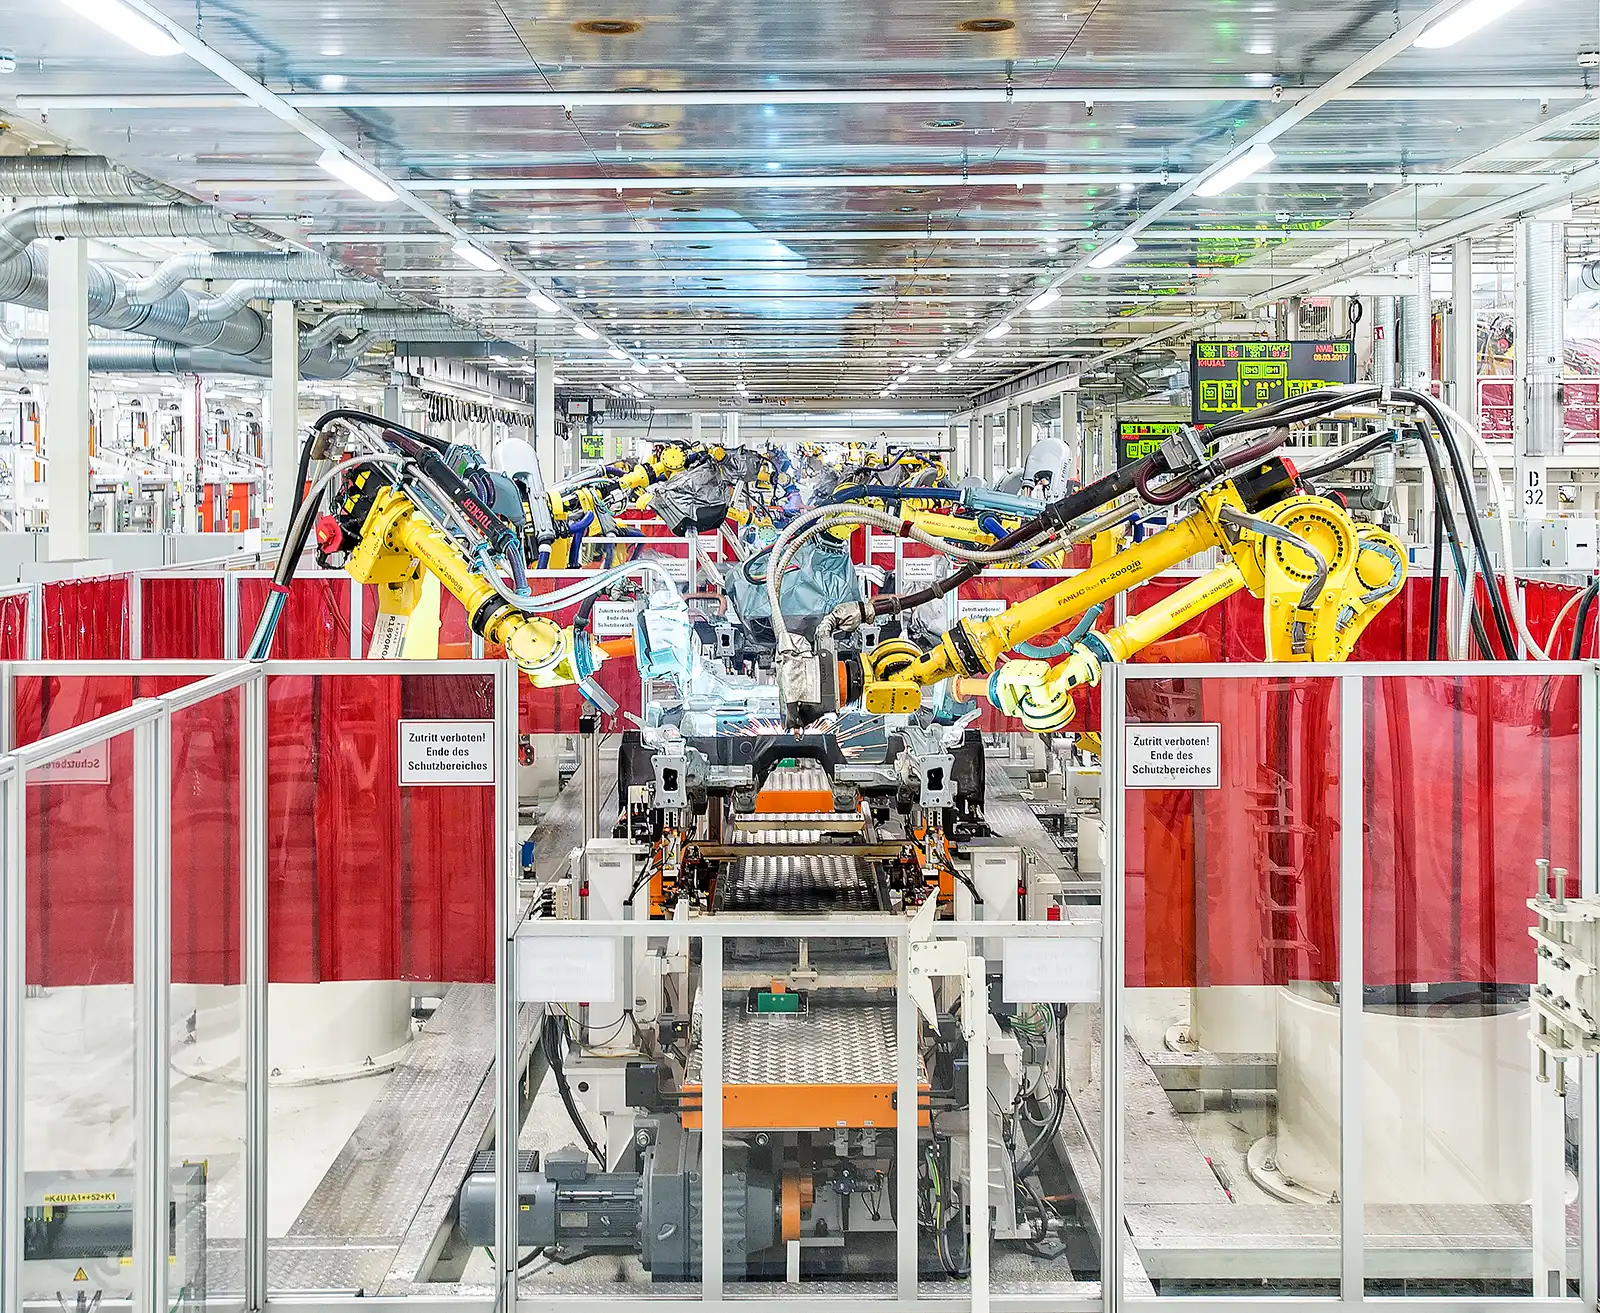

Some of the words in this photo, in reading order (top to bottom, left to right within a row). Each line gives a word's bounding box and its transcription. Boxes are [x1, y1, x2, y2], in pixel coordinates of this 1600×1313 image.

[1529, 471, 1539, 487] D
[184, 483, 195, 493] 26
[1525, 489, 1543, 505] 32
[463, 498, 492, 530] TUCKER
[414, 541, 432, 560] FANUC
[1057, 588, 1086, 606] FANUC
[1100, 560, 1142, 585] R-2000iB
[1170, 602, 1192, 618] FANUC
[408, 733, 438, 743] Zutritt
[440, 732, 486, 743] verboten!
[1133, 736, 1162, 747] Zutritt
[1164, 736, 1210, 746] verboten!
[426, 746, 449, 757] Ende
[452, 746, 470, 757] des
[1150, 750, 1174, 760] Ende
[1176, 750, 1194, 760] des
[408, 760, 488, 771] Schutzbereiches
[1132, 764, 1212, 775] Schutzbereiches
